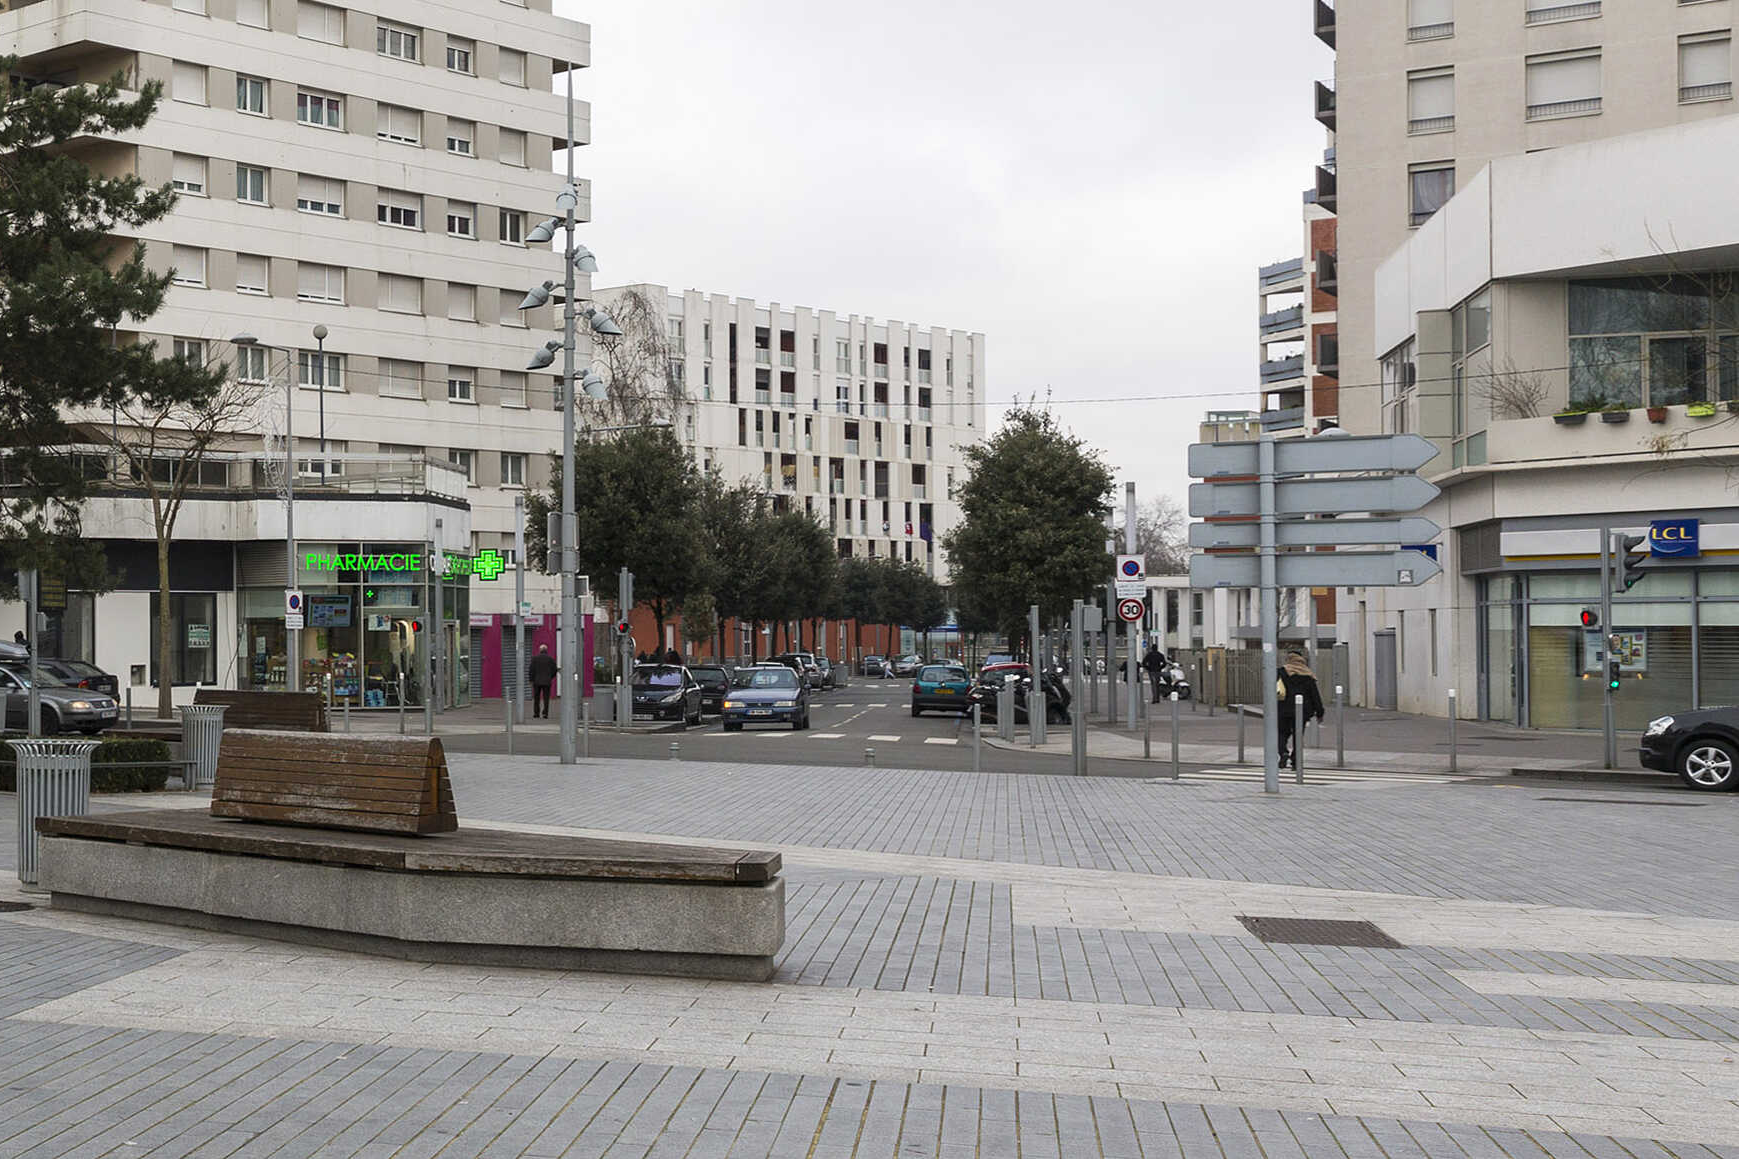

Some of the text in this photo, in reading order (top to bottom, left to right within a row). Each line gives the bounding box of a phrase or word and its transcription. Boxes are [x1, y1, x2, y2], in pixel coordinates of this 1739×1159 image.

[1652, 526, 1693, 540] LCL
[305, 553, 421, 572] PHARMACIE
[1124, 604, 1140, 615] 30
